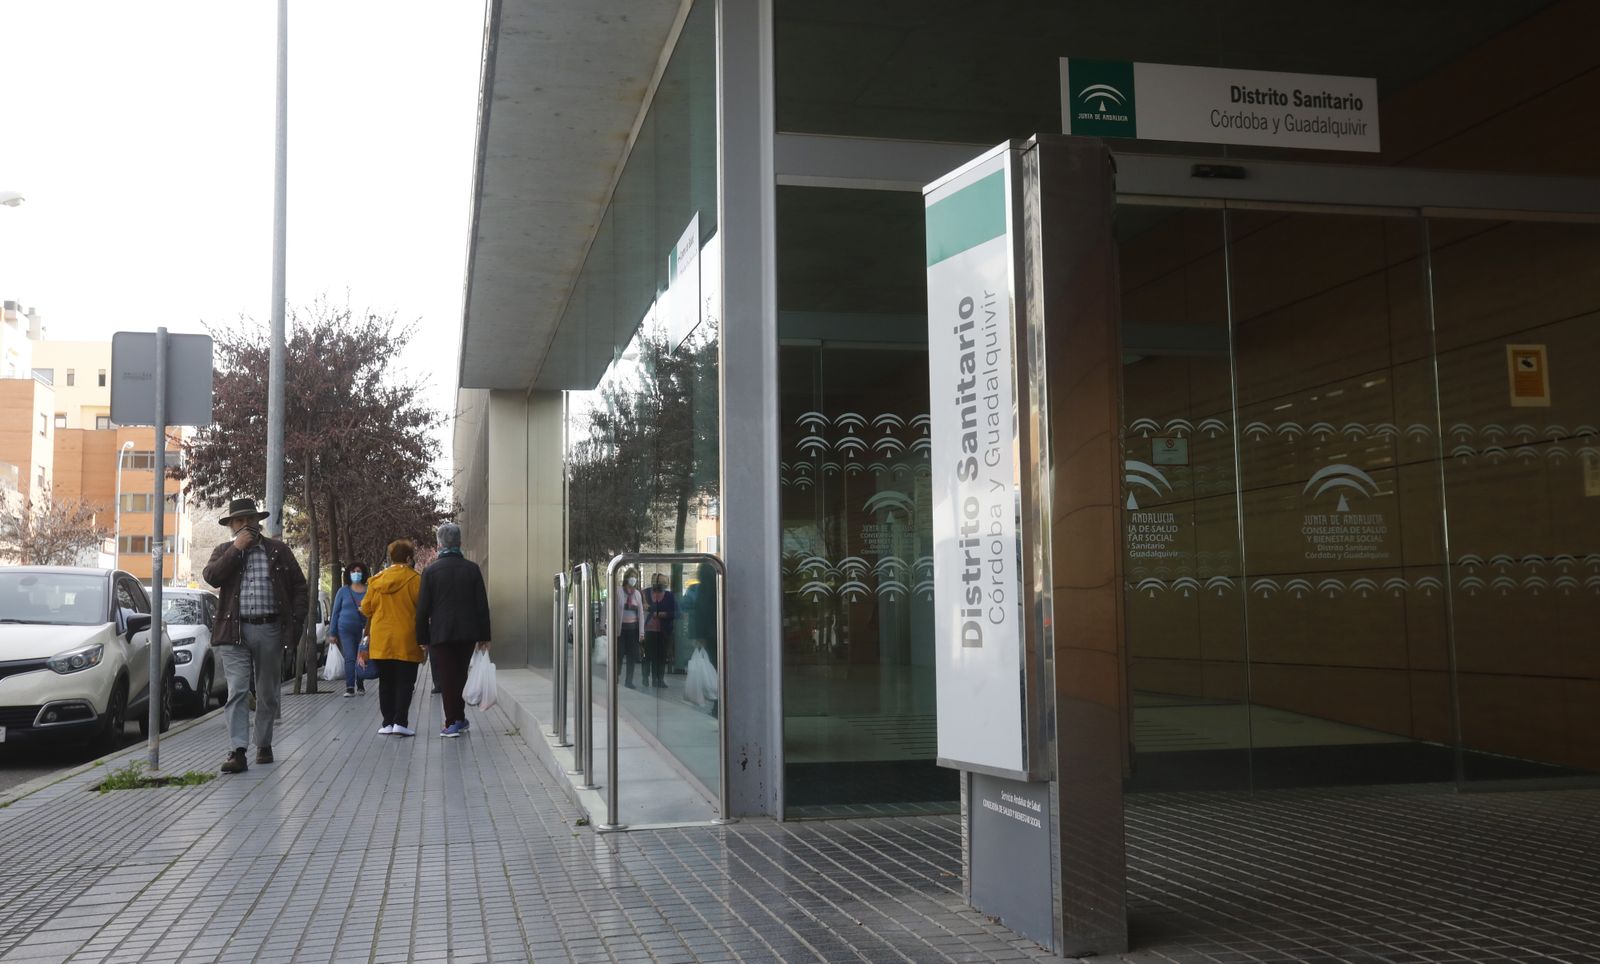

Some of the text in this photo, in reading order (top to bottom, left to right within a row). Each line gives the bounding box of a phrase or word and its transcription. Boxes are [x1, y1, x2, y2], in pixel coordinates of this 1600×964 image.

[1230, 85, 1363, 111] Distrito Sanitario
[1078, 112, 1093, 120] JUNTA
[1210, 109, 1368, 138] Córdoba y Guadalquivir
[980, 289, 1005, 624] Córdoba y Guadalquivir
[953, 296, 983, 649] Distrito Sanitario
[1131, 512, 1175, 524] ANDALUCIA
[1303, 514, 1328, 525] JUNTA
[1330, 514, 1341, 525] DE
[1138, 525, 1150, 533] DE
[1151, 525, 1179, 533] SALUD
[1350, 526, 1360, 534] DE
[1362, 526, 1387, 534] SALUD
[1145, 534, 1175, 542] SOCIAL
[1313, 535, 1354, 543] BIENESTAR
[1131, 542, 1166, 550] Sanitario
